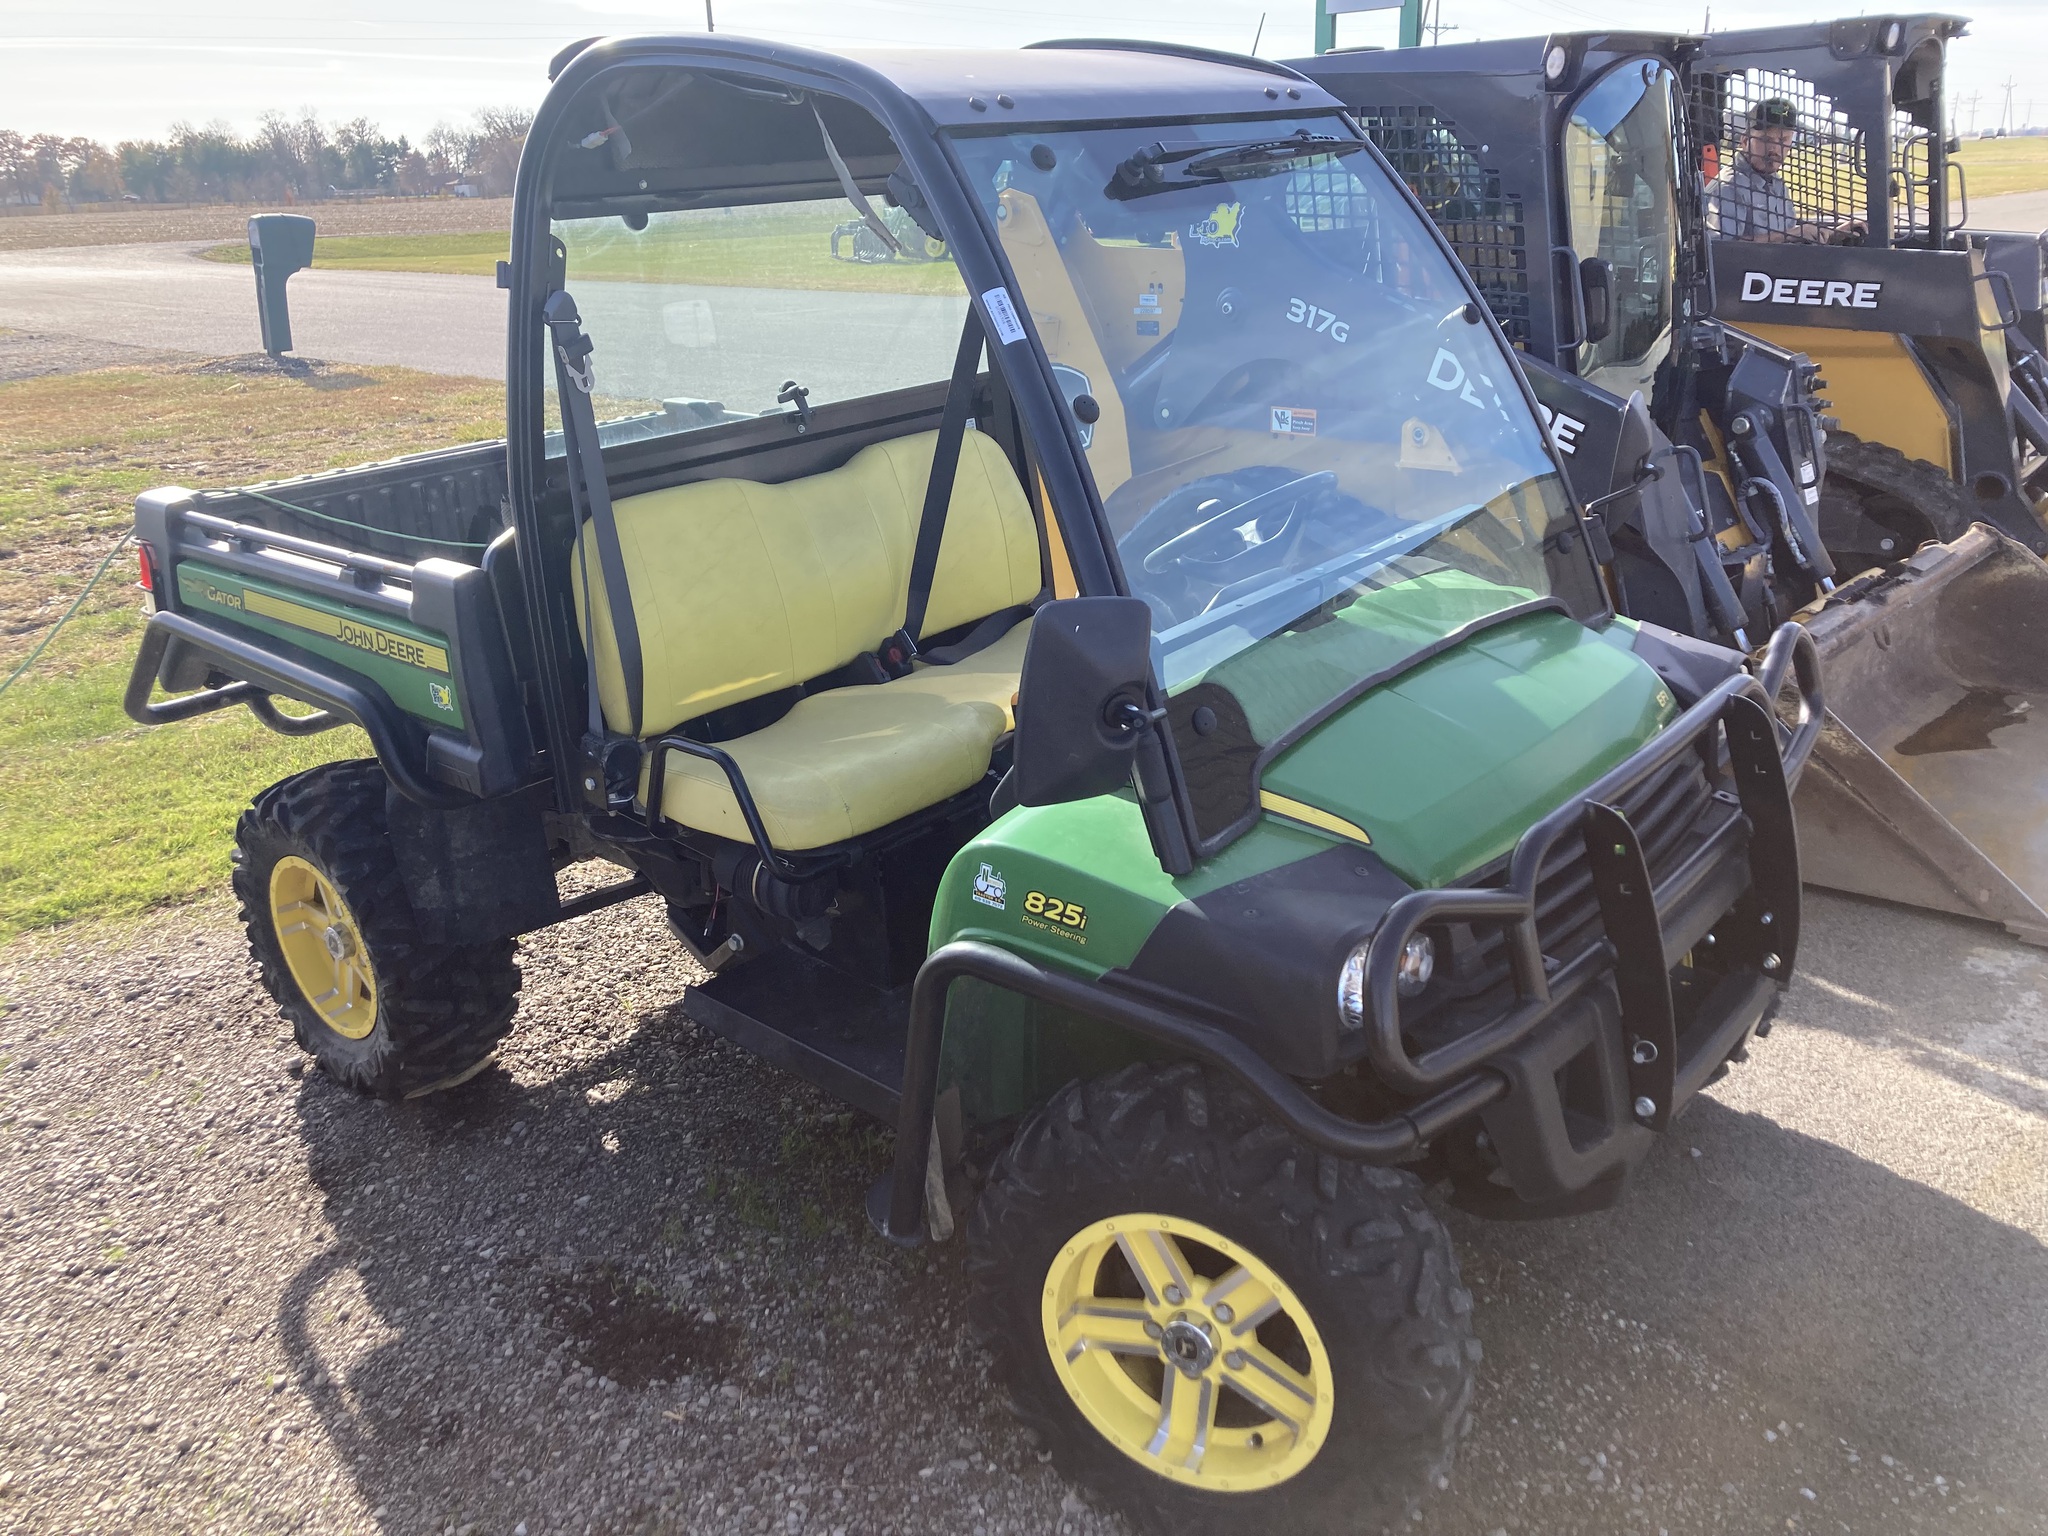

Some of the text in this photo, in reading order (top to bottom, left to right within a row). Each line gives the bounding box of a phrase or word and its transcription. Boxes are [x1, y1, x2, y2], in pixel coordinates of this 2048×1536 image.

[1741, 272, 1881, 308] DEERE
[1286, 297, 1350, 343] 317G
[207, 586, 241, 609] GATOR
[337, 620, 426, 665] JOHN DEERE
[1024, 891, 1088, 930] 825i
[1021, 915, 1087, 945] Power Steering
